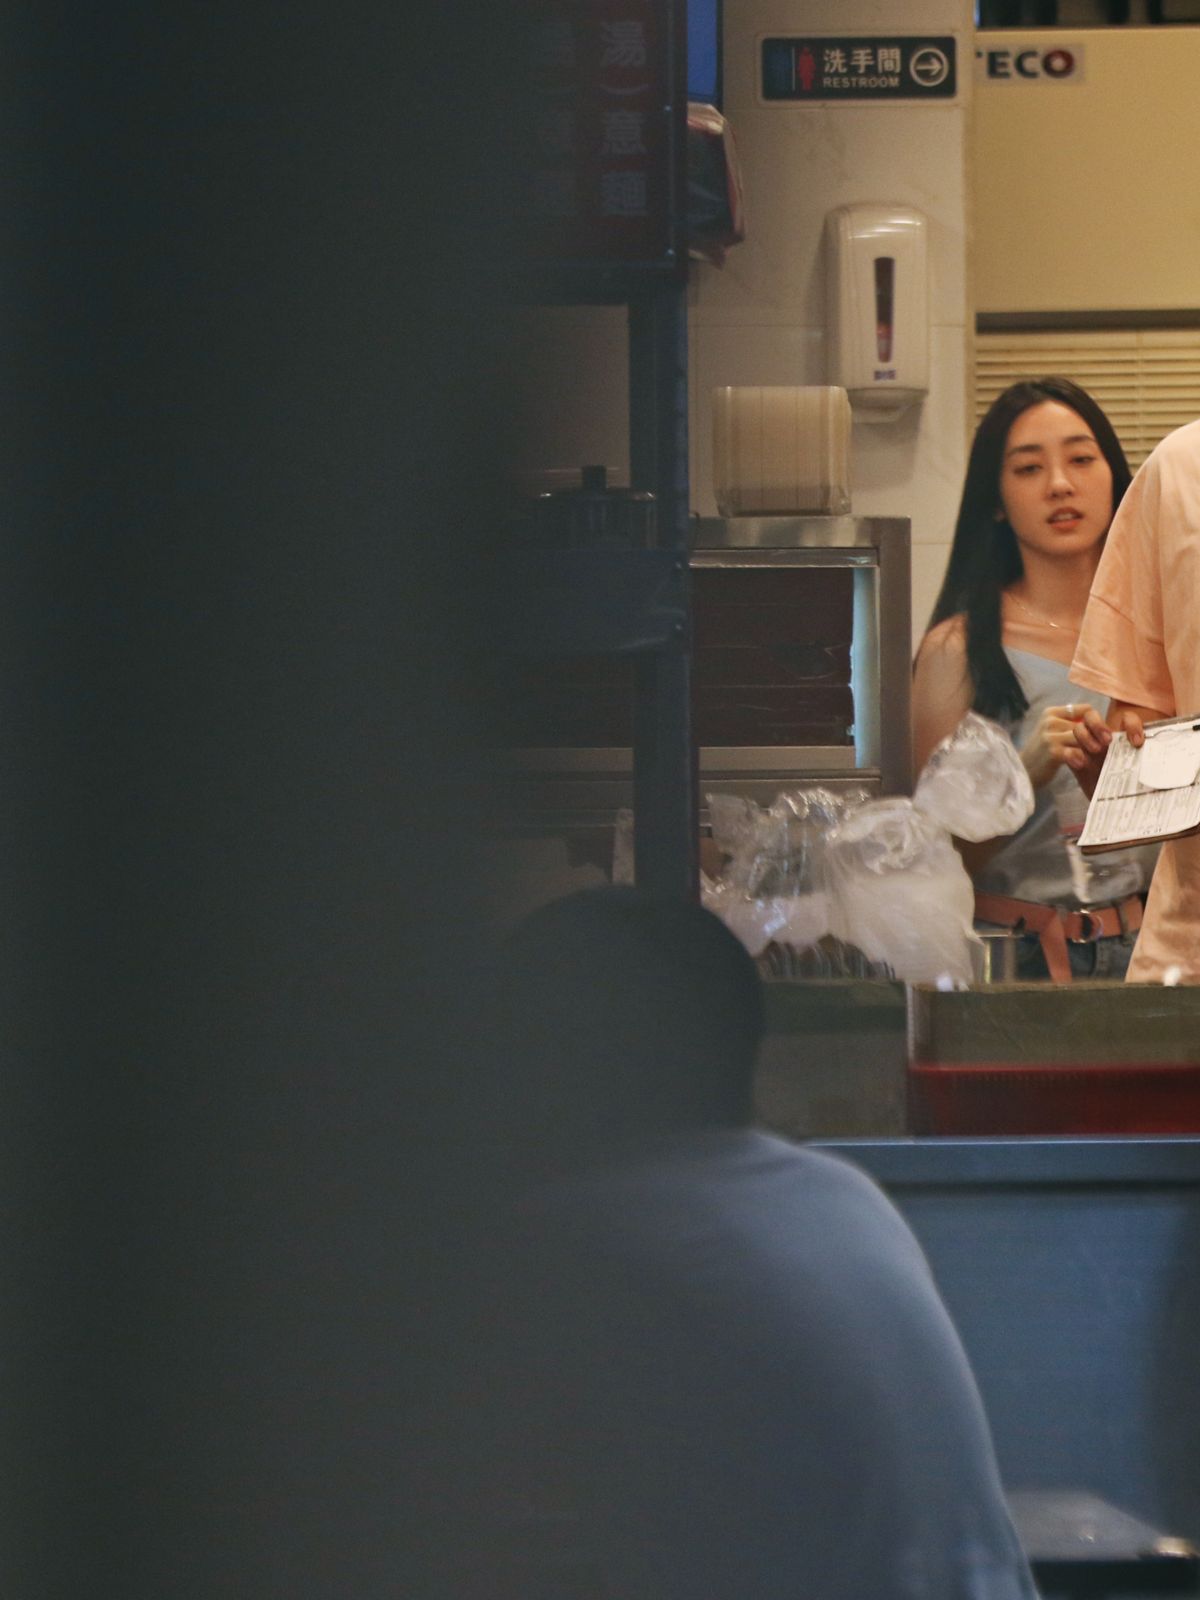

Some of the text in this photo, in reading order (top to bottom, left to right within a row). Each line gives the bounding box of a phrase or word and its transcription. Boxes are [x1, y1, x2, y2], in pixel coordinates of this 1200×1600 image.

[823, 48, 901, 74] 洗手間
[976, 50, 1075, 79] ECO
[823, 76, 900, 89] RESTROOM
